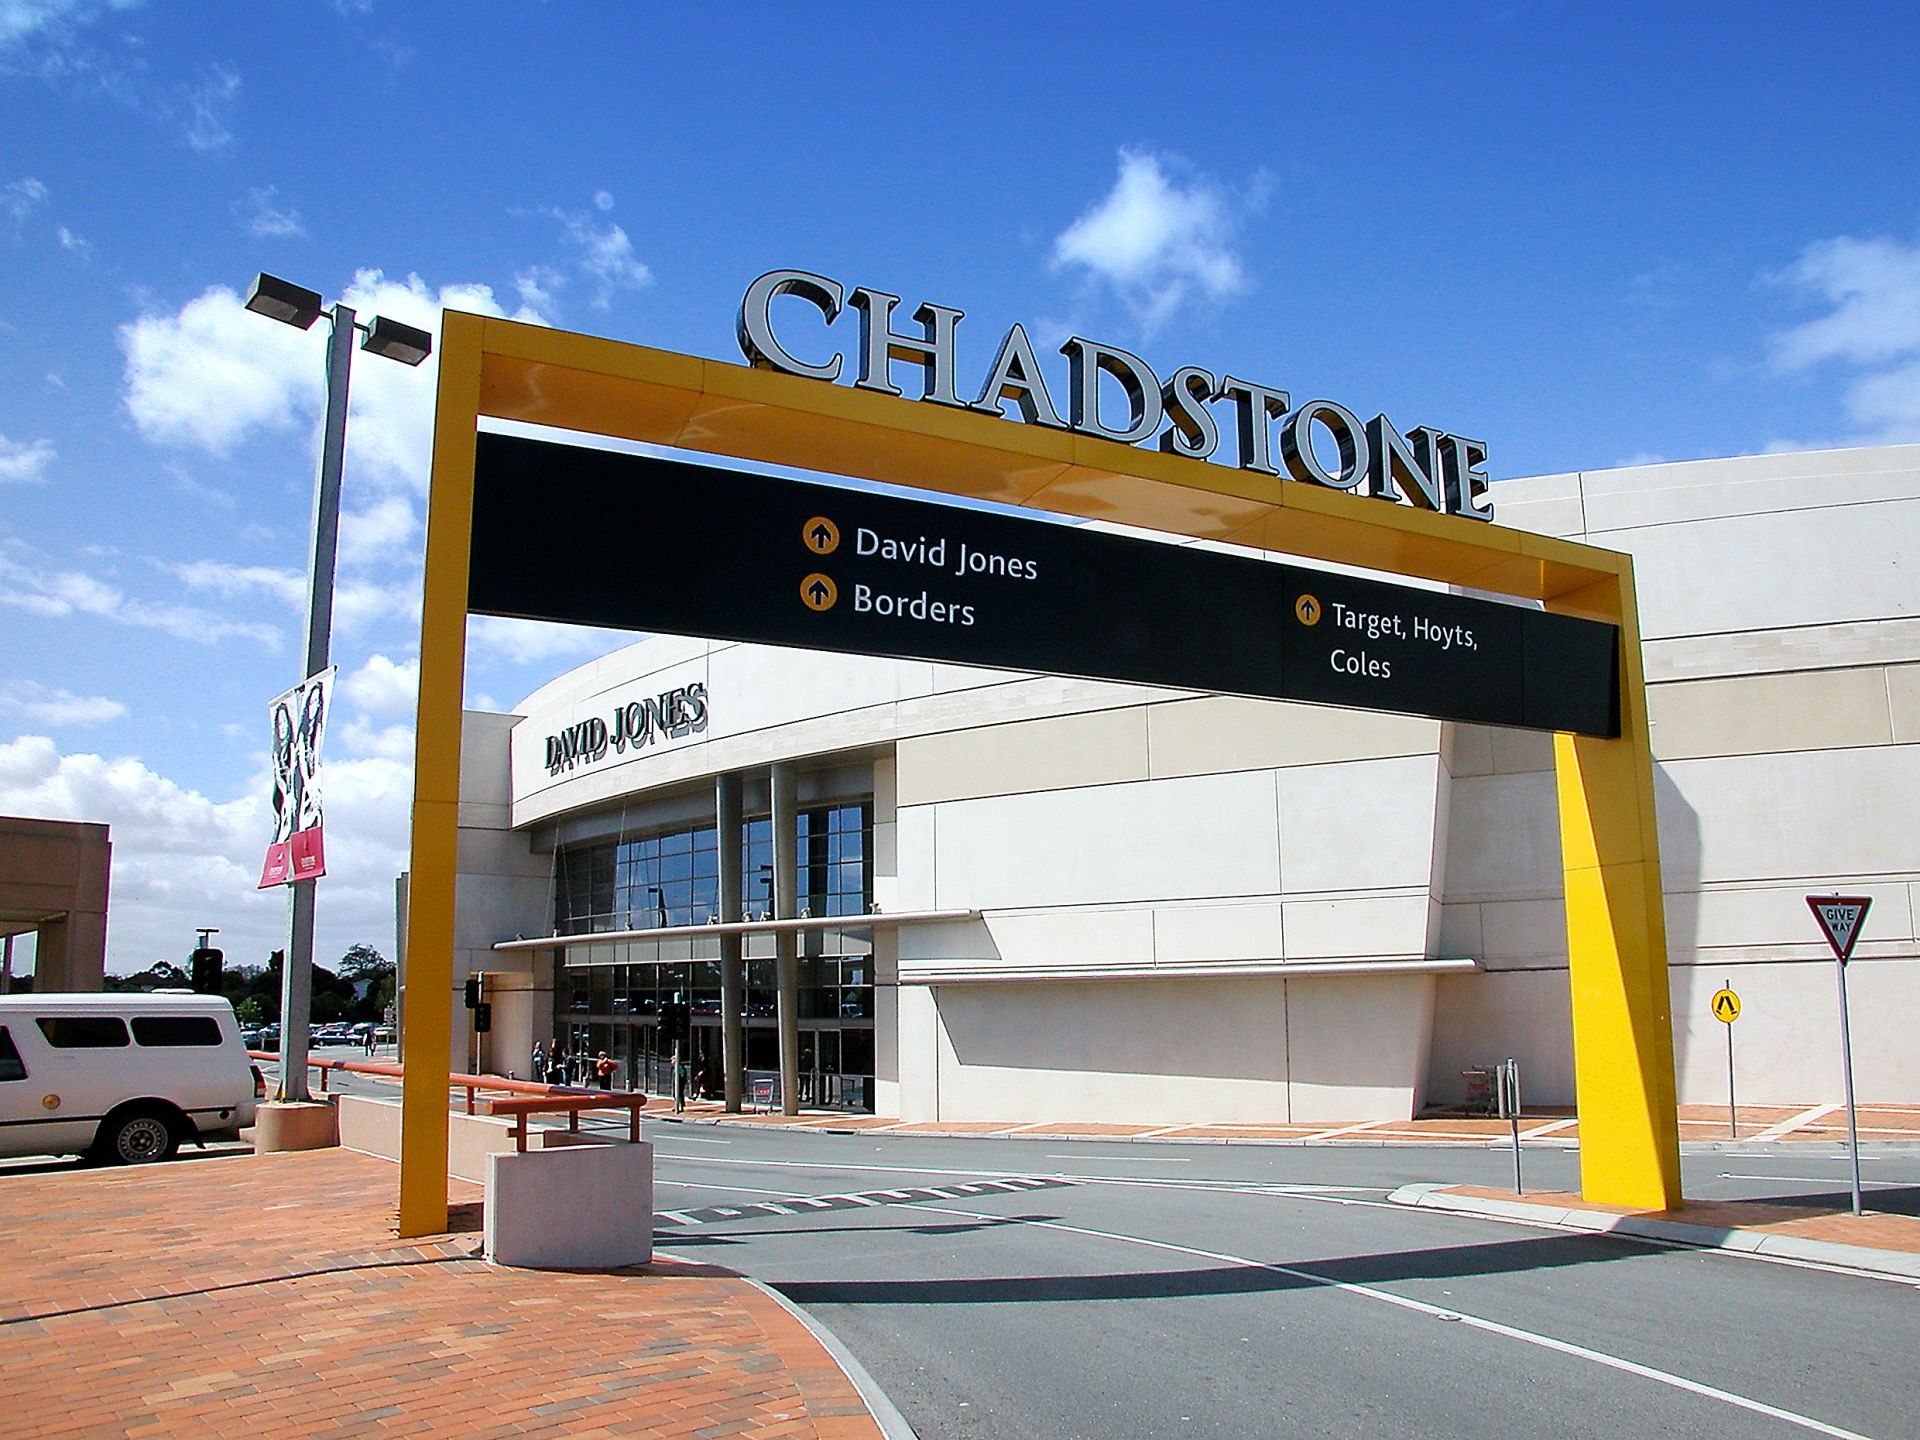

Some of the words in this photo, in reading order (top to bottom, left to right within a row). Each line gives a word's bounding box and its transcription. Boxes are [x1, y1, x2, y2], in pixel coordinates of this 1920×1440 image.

[738, 269, 1495, 522] CHADSTONE
[856, 527, 945, 566] David
[955, 543, 1038, 580] Jones
[854, 583, 975, 626] Borders
[1332, 602, 1406, 640] Target,
[1414, 616, 1478, 651] Hoyts,
[1330, 649, 1391, 679] Coles
[544, 717, 608, 775] DAVID
[610, 682, 709, 755] JONES
[1826, 908, 1855, 921] GIVE
[1832, 922, 1852, 932] WAY
